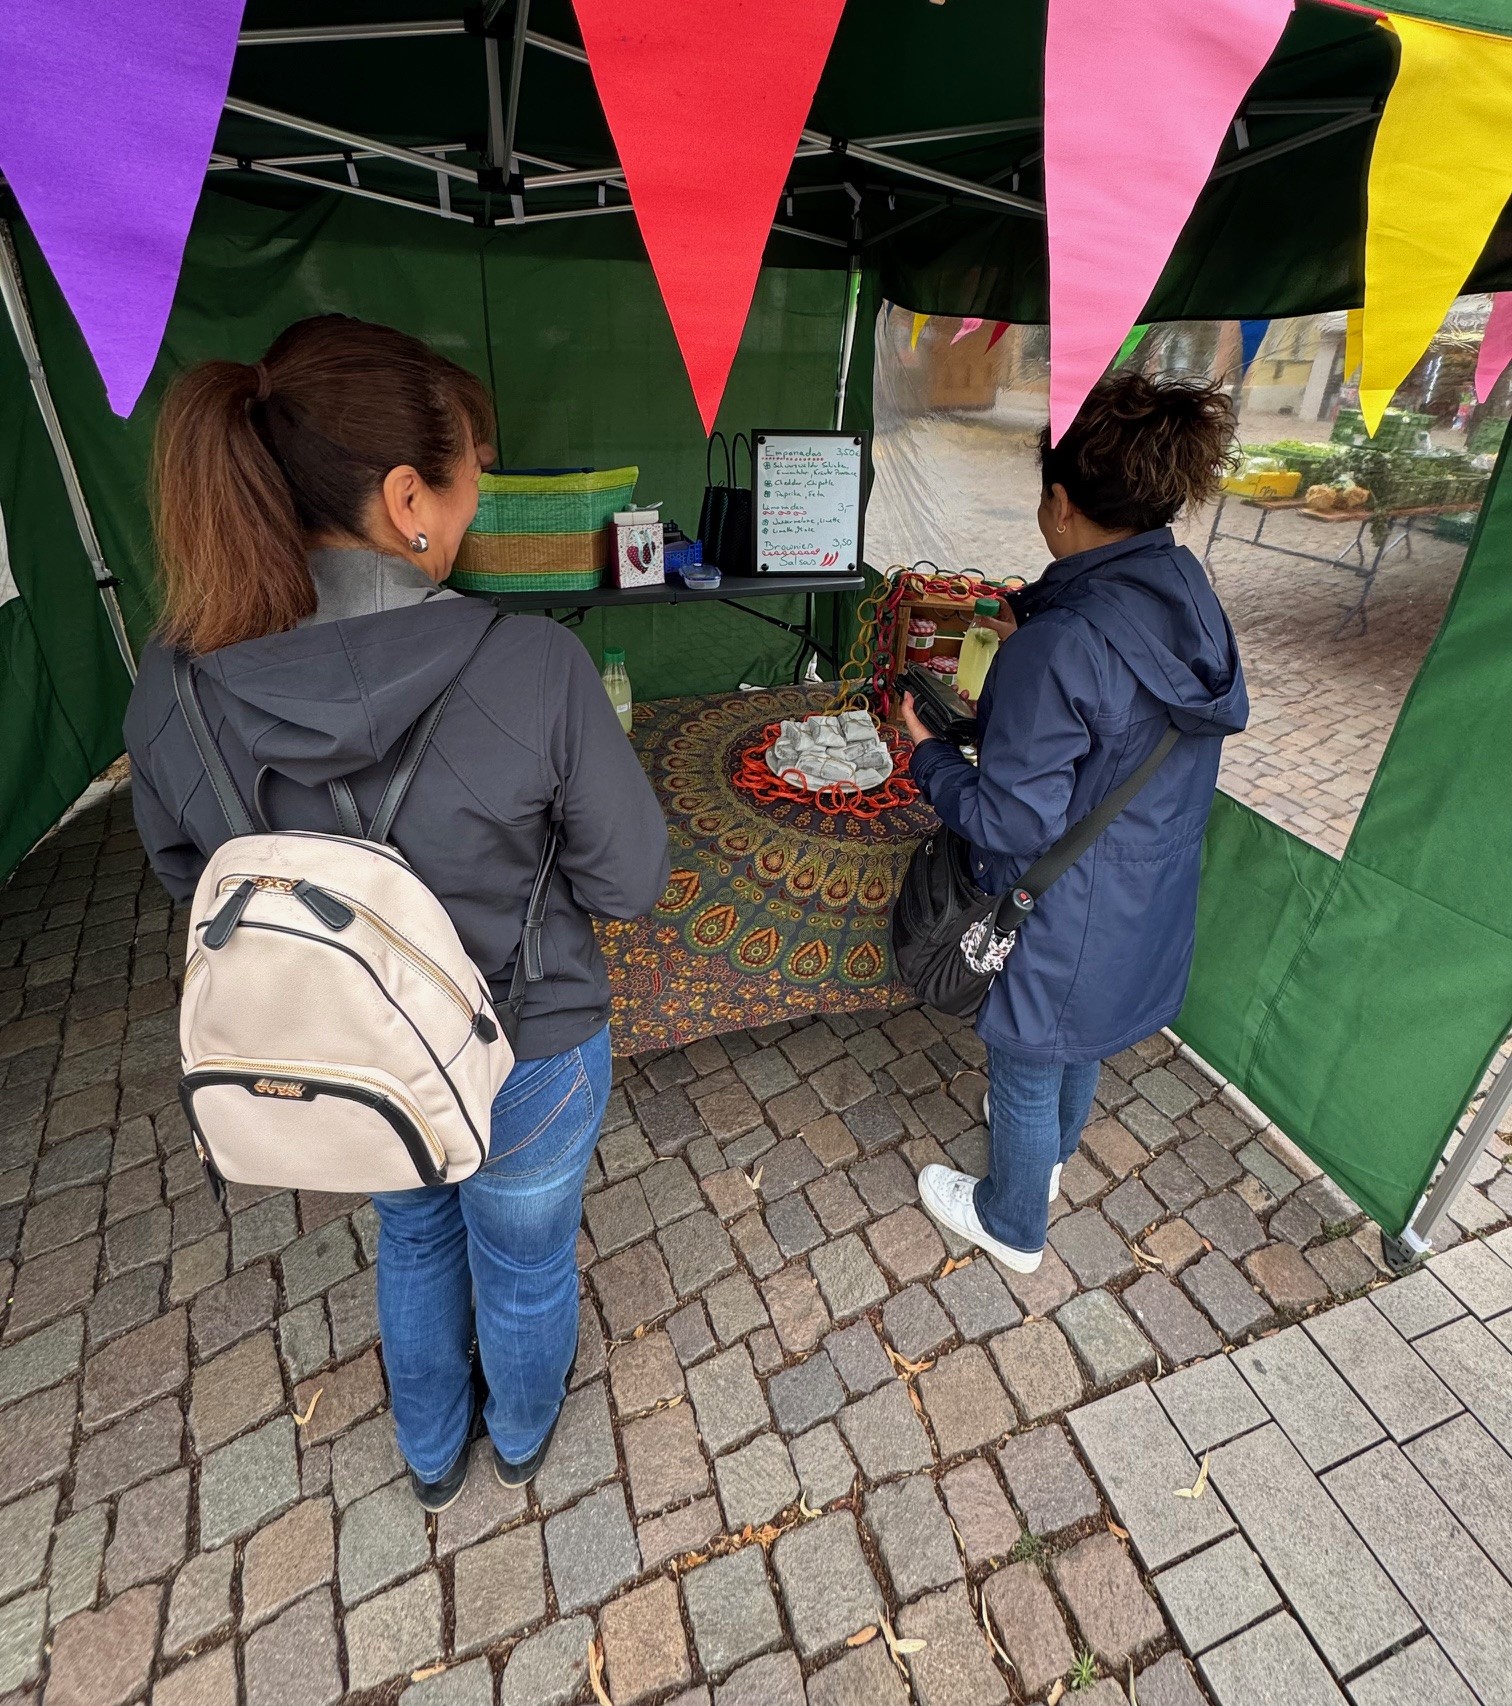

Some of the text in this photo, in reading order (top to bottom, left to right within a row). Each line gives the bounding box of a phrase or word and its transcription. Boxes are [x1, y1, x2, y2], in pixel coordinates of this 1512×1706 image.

[765, 445, 822, 459] Empanadas
[808, 490, 825, 498] Feta
[762, 503, 804, 511] Limonaden
[764, 540, 814, 551] Brownies
[832, 538, 852, 549] 3,50
[779, 556, 817, 567] Salsas
